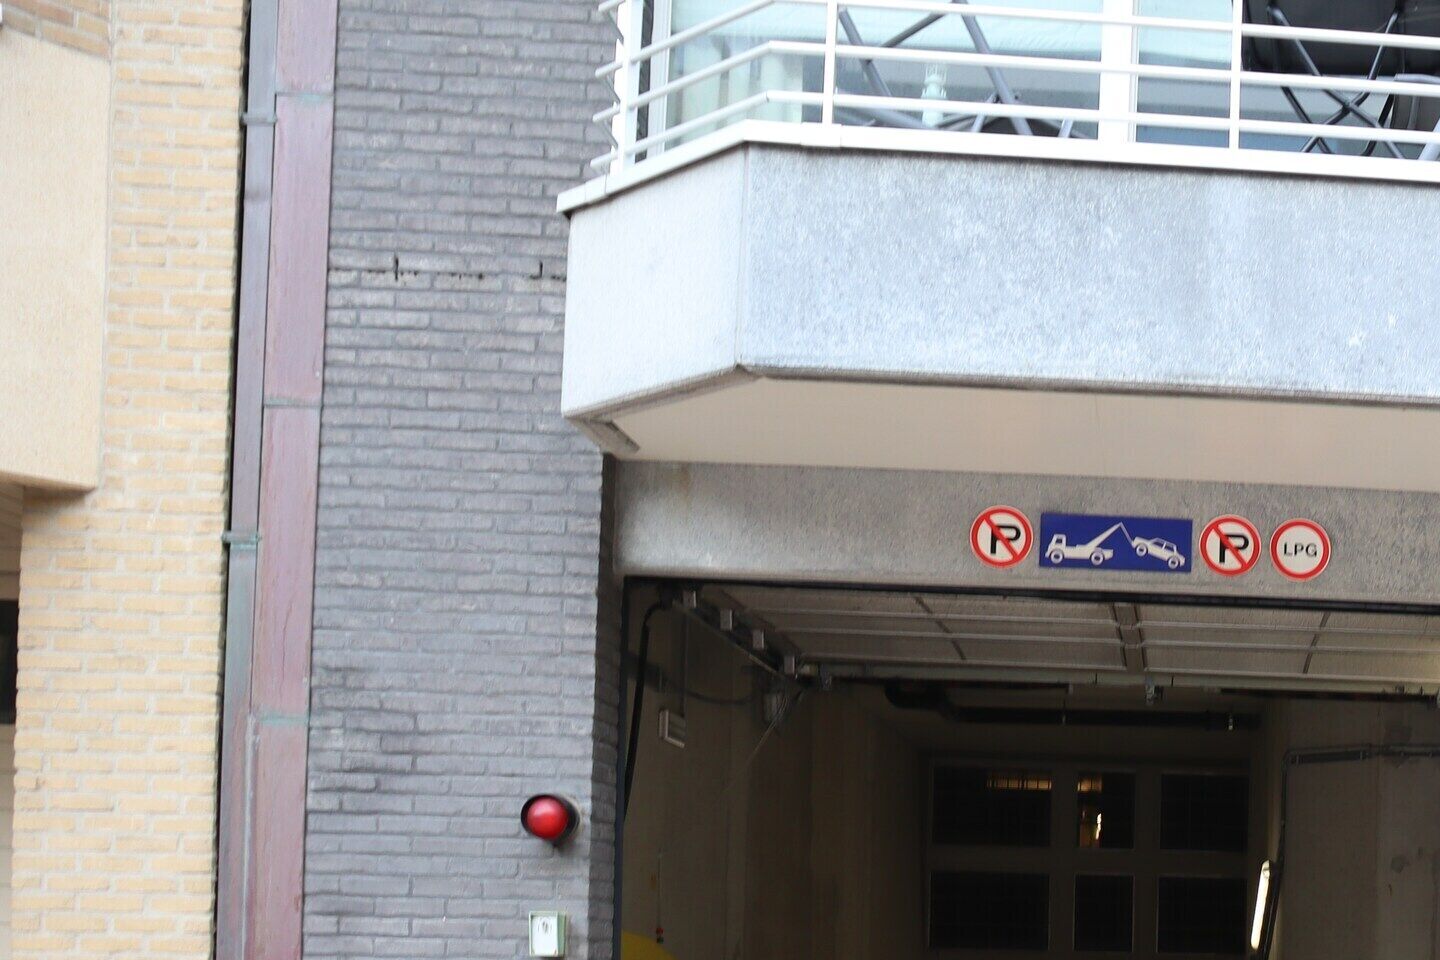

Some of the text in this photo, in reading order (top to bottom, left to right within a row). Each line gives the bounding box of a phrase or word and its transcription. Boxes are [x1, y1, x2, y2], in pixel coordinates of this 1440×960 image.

[990, 524, 1021, 554] P
[1219, 533, 1249, 563] P
[1284, 543, 1317, 557] LPG
